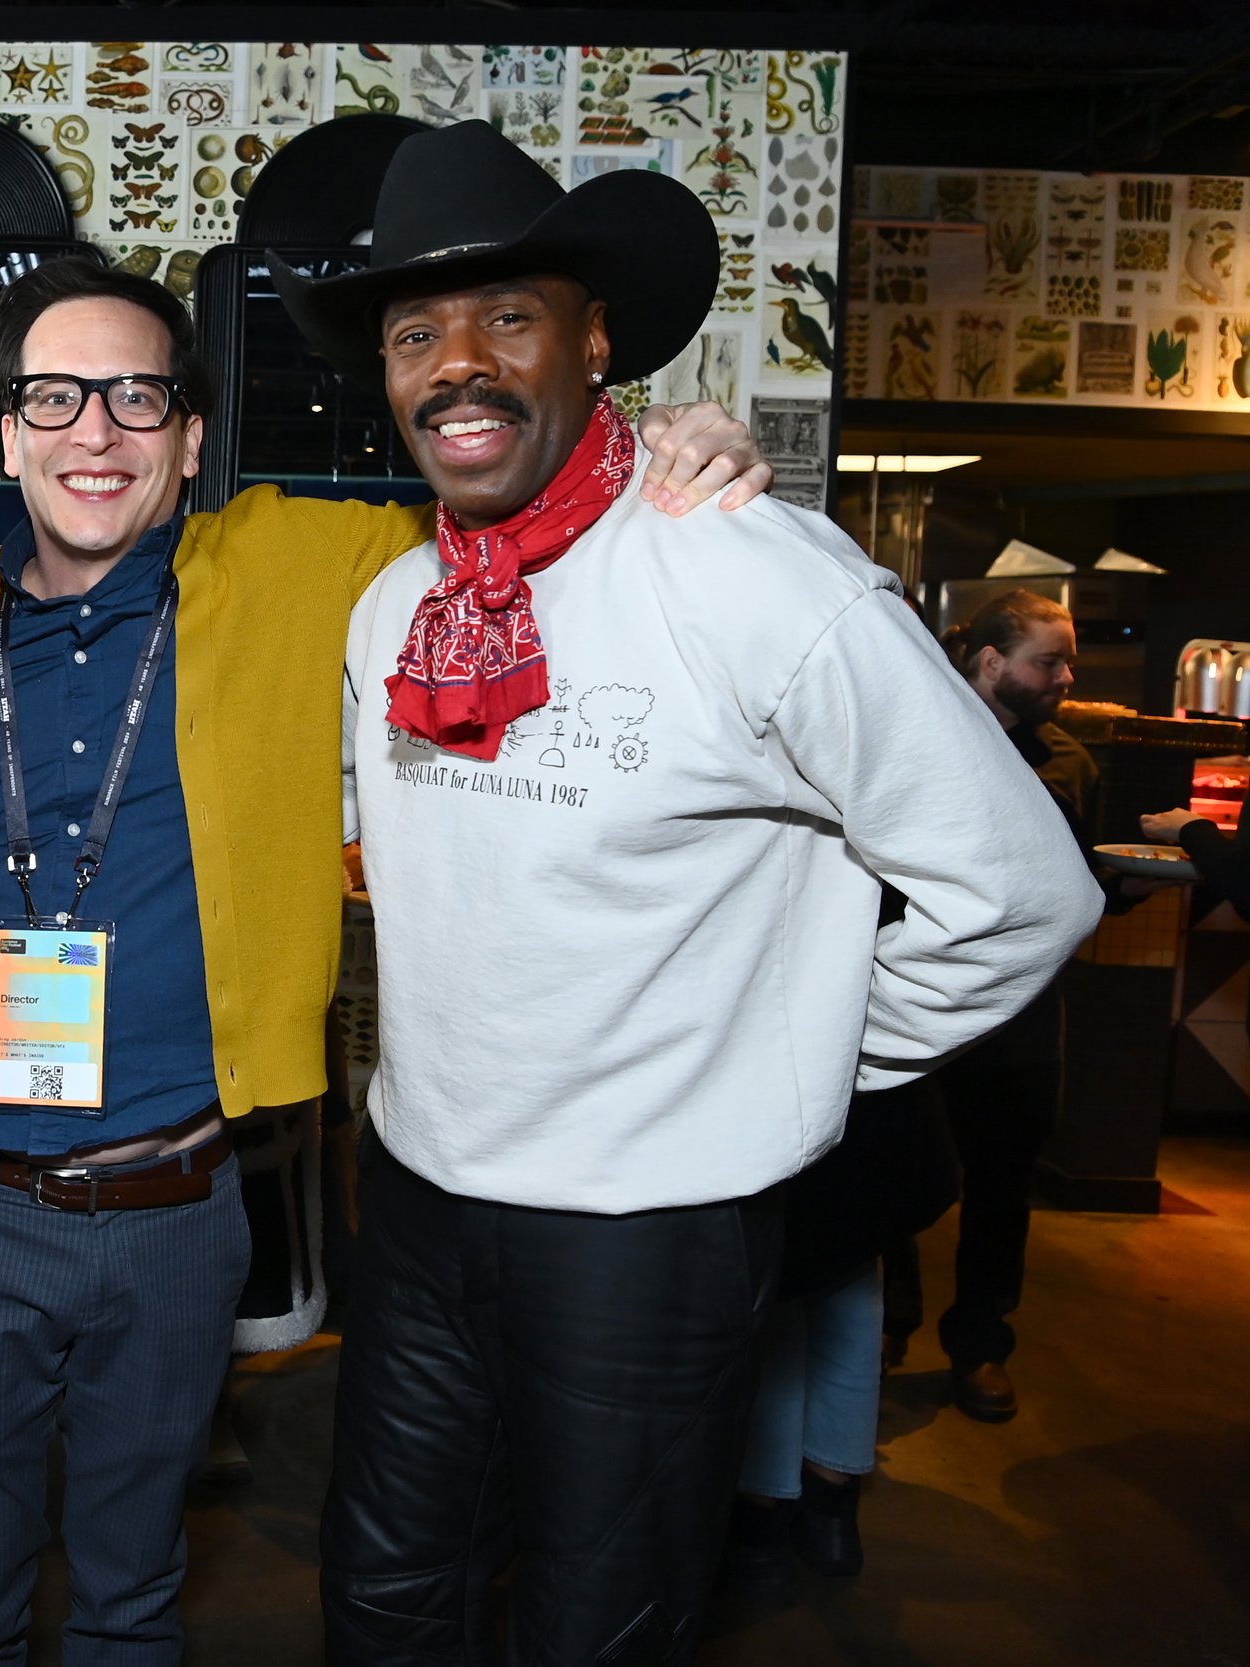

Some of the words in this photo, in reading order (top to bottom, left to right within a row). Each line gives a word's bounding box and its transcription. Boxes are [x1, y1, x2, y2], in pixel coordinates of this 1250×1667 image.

[0, 697, 10, 722] UTAH
[104, 783, 116, 806] SUNDANCE
[111, 769, 119, 782] FILM
[115, 746, 127, 769] FESTIVAL
[123, 732, 131, 745] 2024
[128, 699, 142, 725] UTAH
[141, 669, 149, 683] YEARS
[147, 627, 161, 659] INDEPENDENTS
[395, 761, 447, 787] BASQUIAT
[450, 769, 468, 790] for
[471, 772, 502, 796] LUNA
[507, 776, 543, 802] LUNA
[550, 783, 589, 808] 1987
[0, 994, 39, 1004] Director
